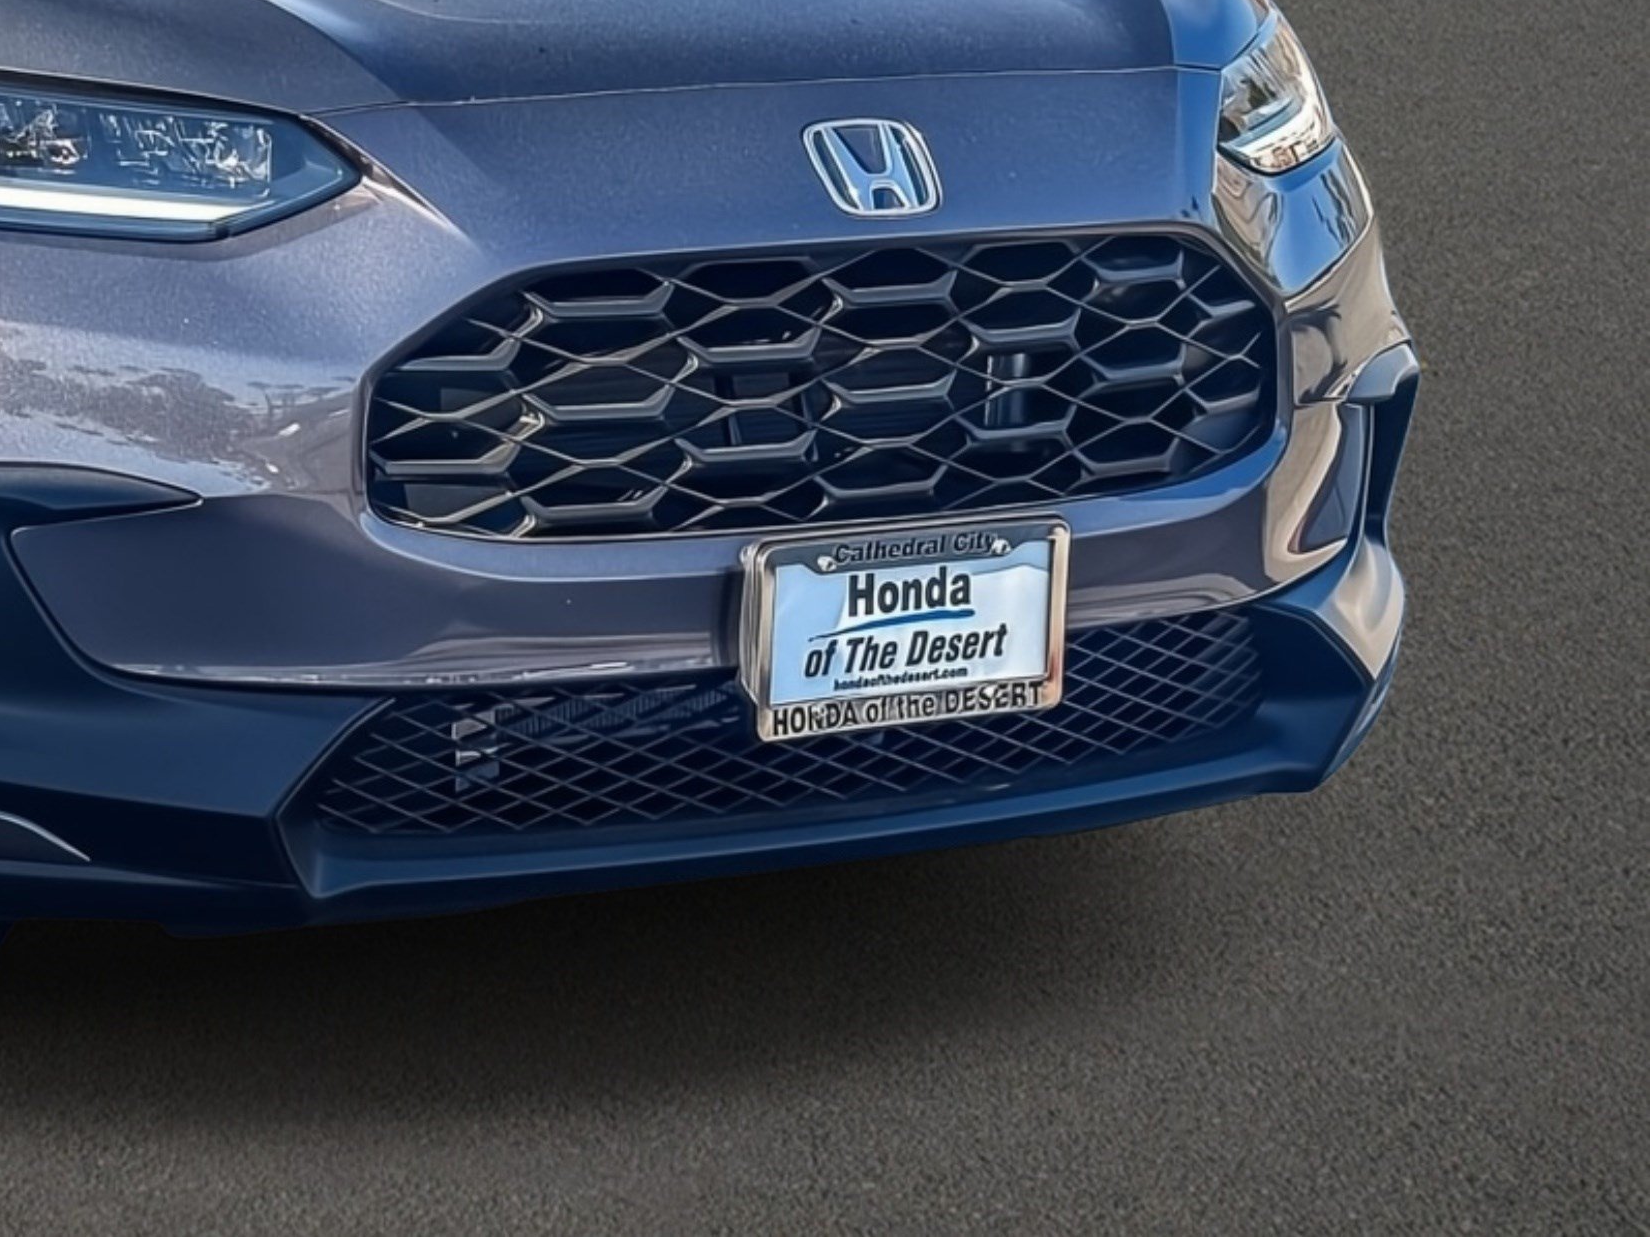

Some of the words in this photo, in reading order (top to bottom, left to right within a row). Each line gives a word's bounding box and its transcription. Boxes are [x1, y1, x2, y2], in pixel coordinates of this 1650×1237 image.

[834, 535, 946, 563] Cathedral
[847, 565, 972, 618] Honda
[804, 638, 837, 678] of
[844, 635, 898, 674] The
[906, 622, 1008, 667] Desert
[832, 666, 968, 692] hondaofthedesert.com
[772, 700, 859, 737] HONDA
[865, 695, 888, 724] of
[896, 692, 936, 720] the
[944, 680, 1045, 714] DESERT
